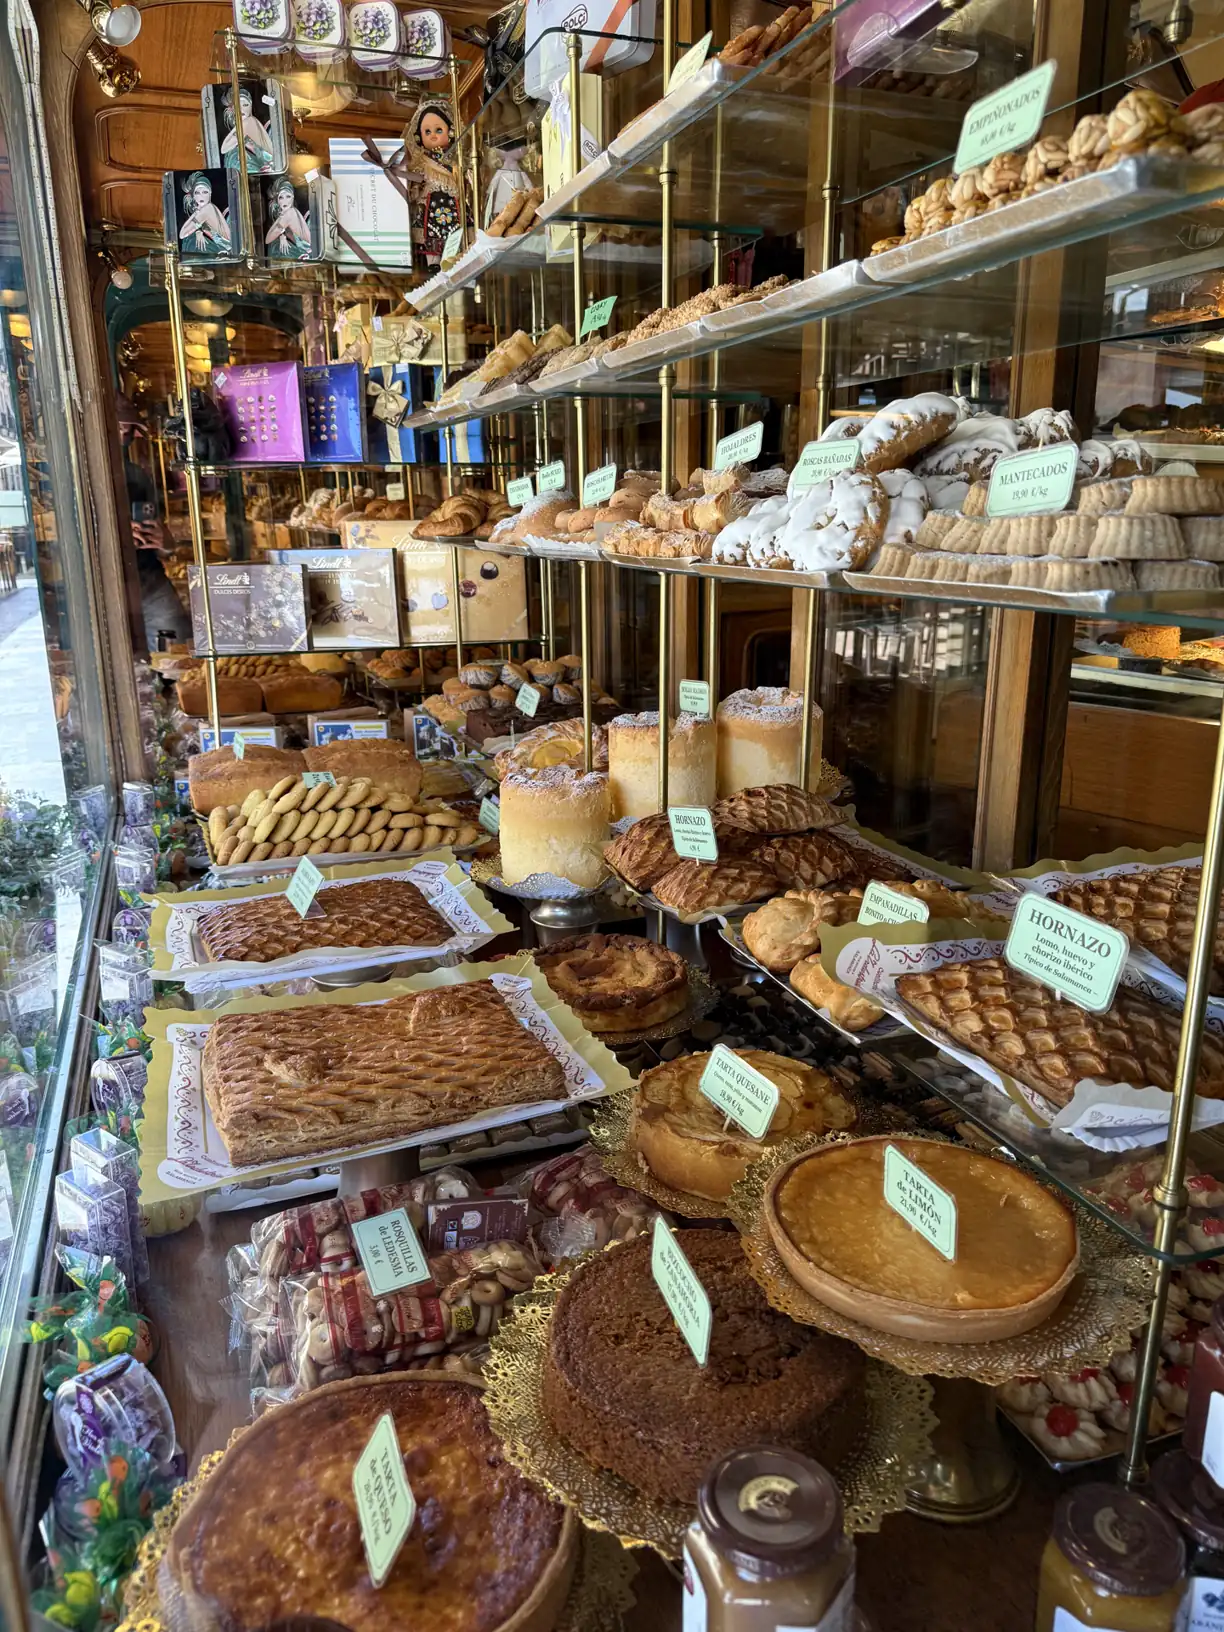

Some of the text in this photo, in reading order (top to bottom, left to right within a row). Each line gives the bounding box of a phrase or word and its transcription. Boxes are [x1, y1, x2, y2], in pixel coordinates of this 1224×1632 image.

[968, 87, 1041, 135] EMPIÑONADOS
[721, 431, 757, 455] HOJALDRES
[803, 453, 852, 467] ROSCAS BAÑADAS
[999, 462, 1068, 487] MANTECADOS
[213, 573, 242, 586] Lindt
[311, 556, 344, 569] Lindt
[674, 815, 706, 827] HORNAZO
[865, 906, 883, 921] BONITO
[869, 893, 918, 920] EMPANADILLAS
[1028, 908, 1112, 959] HORNAZO
[1035, 933, 1096, 971] Lomo, huevo y
[1024, 952, 1092, 995] Típico de Salamanca
[1032, 944, 1093, 982] chorizo ibérico
[715, 1055, 770, 1106] TARTA QUESANE
[732, 1099, 745, 1117] €/kg
[897, 1180, 941, 1225] de LIMÓN
[903, 1169, 935, 1206] TARTA
[378, 1225, 404, 1278] de LEDESMA
[390, 1219, 418, 1273] ROSQUILLAS
[381, 1446, 397, 1508] TARTA
[370, 1458, 392, 1535] de QUESO
